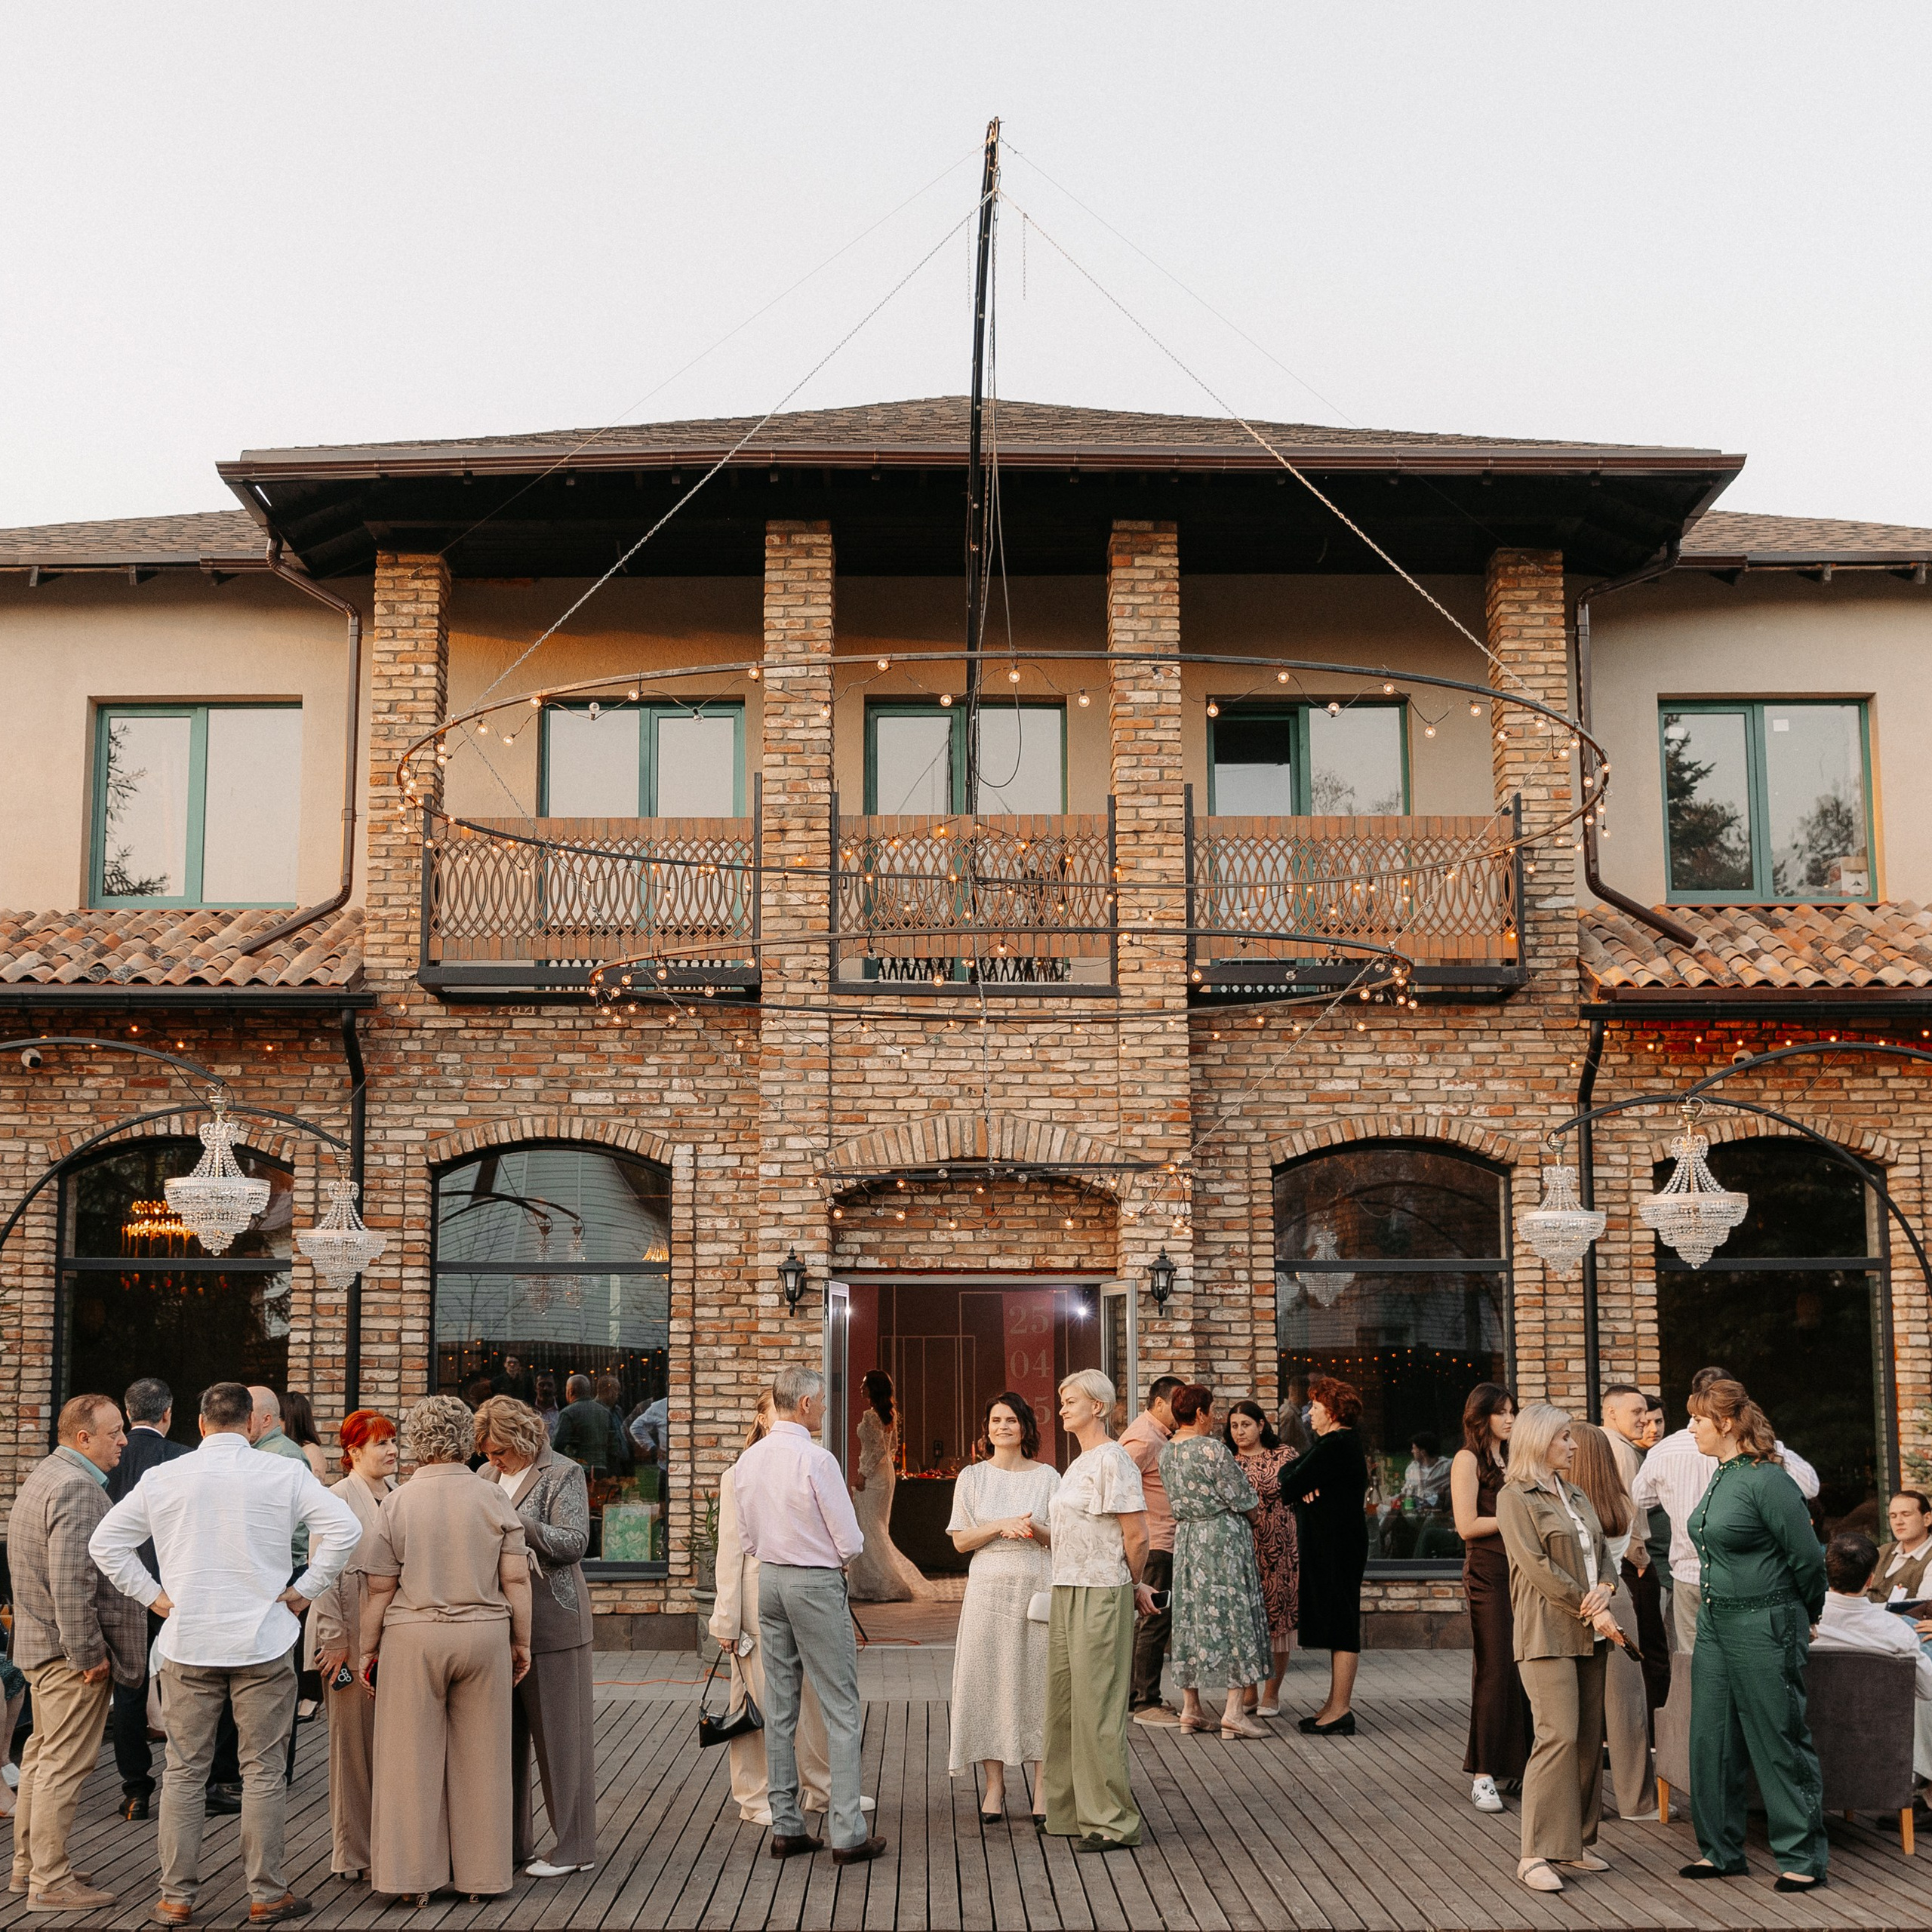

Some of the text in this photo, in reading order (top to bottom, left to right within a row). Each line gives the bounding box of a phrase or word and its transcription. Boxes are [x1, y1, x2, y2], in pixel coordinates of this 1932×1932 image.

[1008, 1306, 1049, 1334] 25
[1010, 1349, 1051, 1379] 04
[1025, 1396, 1051, 1424] 5
